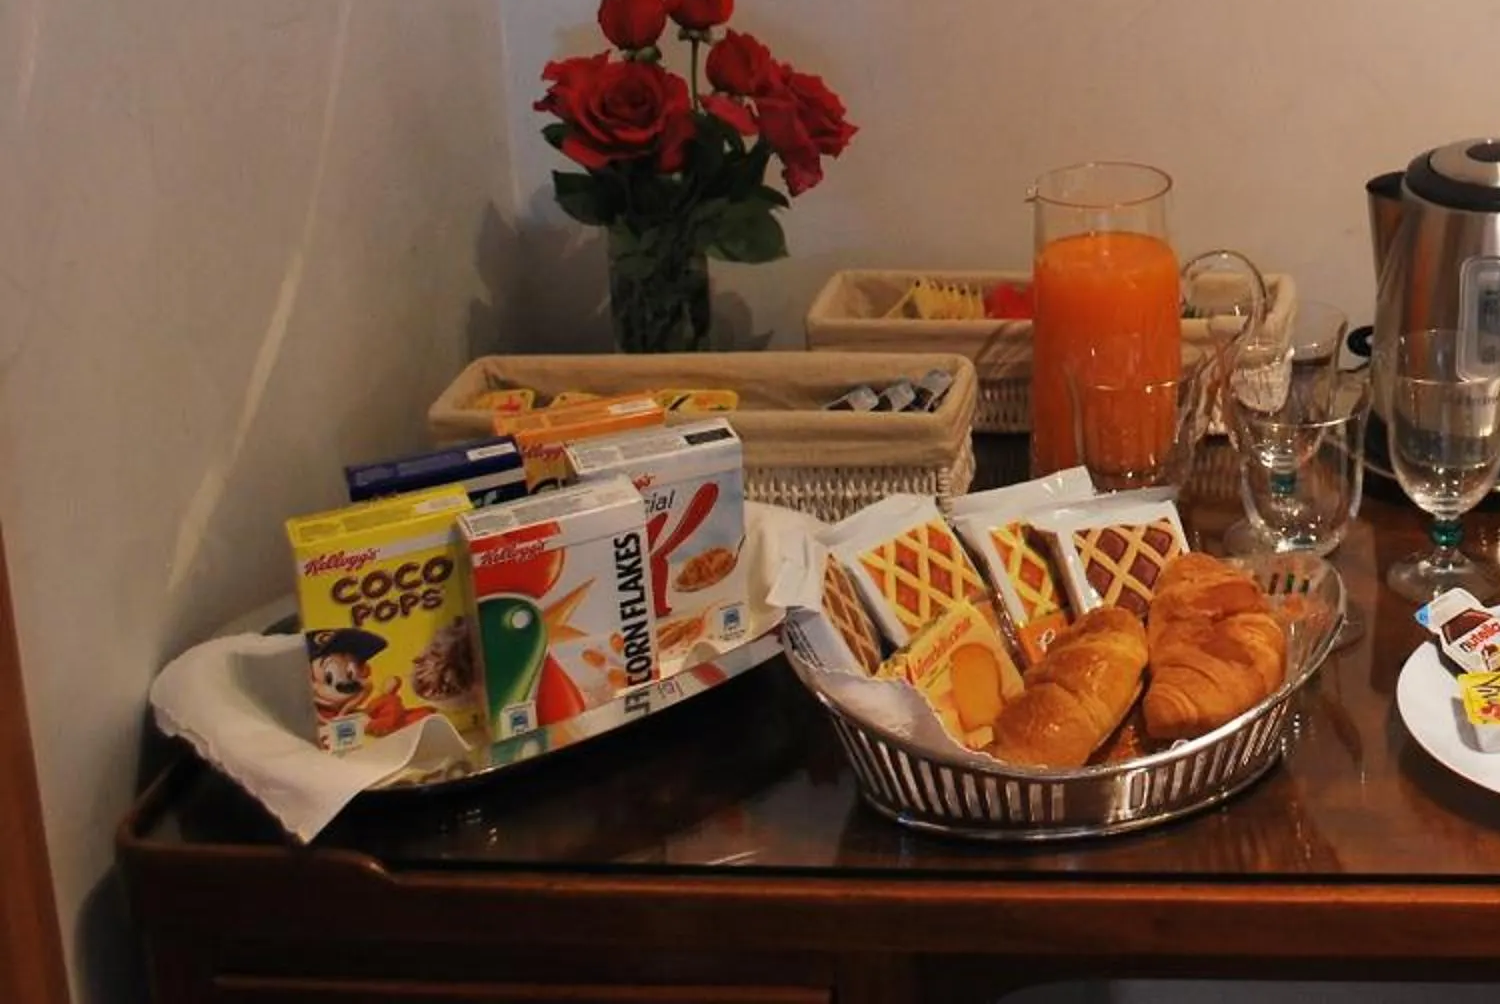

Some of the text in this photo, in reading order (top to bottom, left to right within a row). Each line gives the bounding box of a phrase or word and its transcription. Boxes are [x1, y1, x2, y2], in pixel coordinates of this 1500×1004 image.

[304, 548, 381, 577] Kellogg's
[331, 556, 454, 604] COCO
[352, 588, 443, 627] POPS
[613, 532, 653, 686] CORN FLAKES
